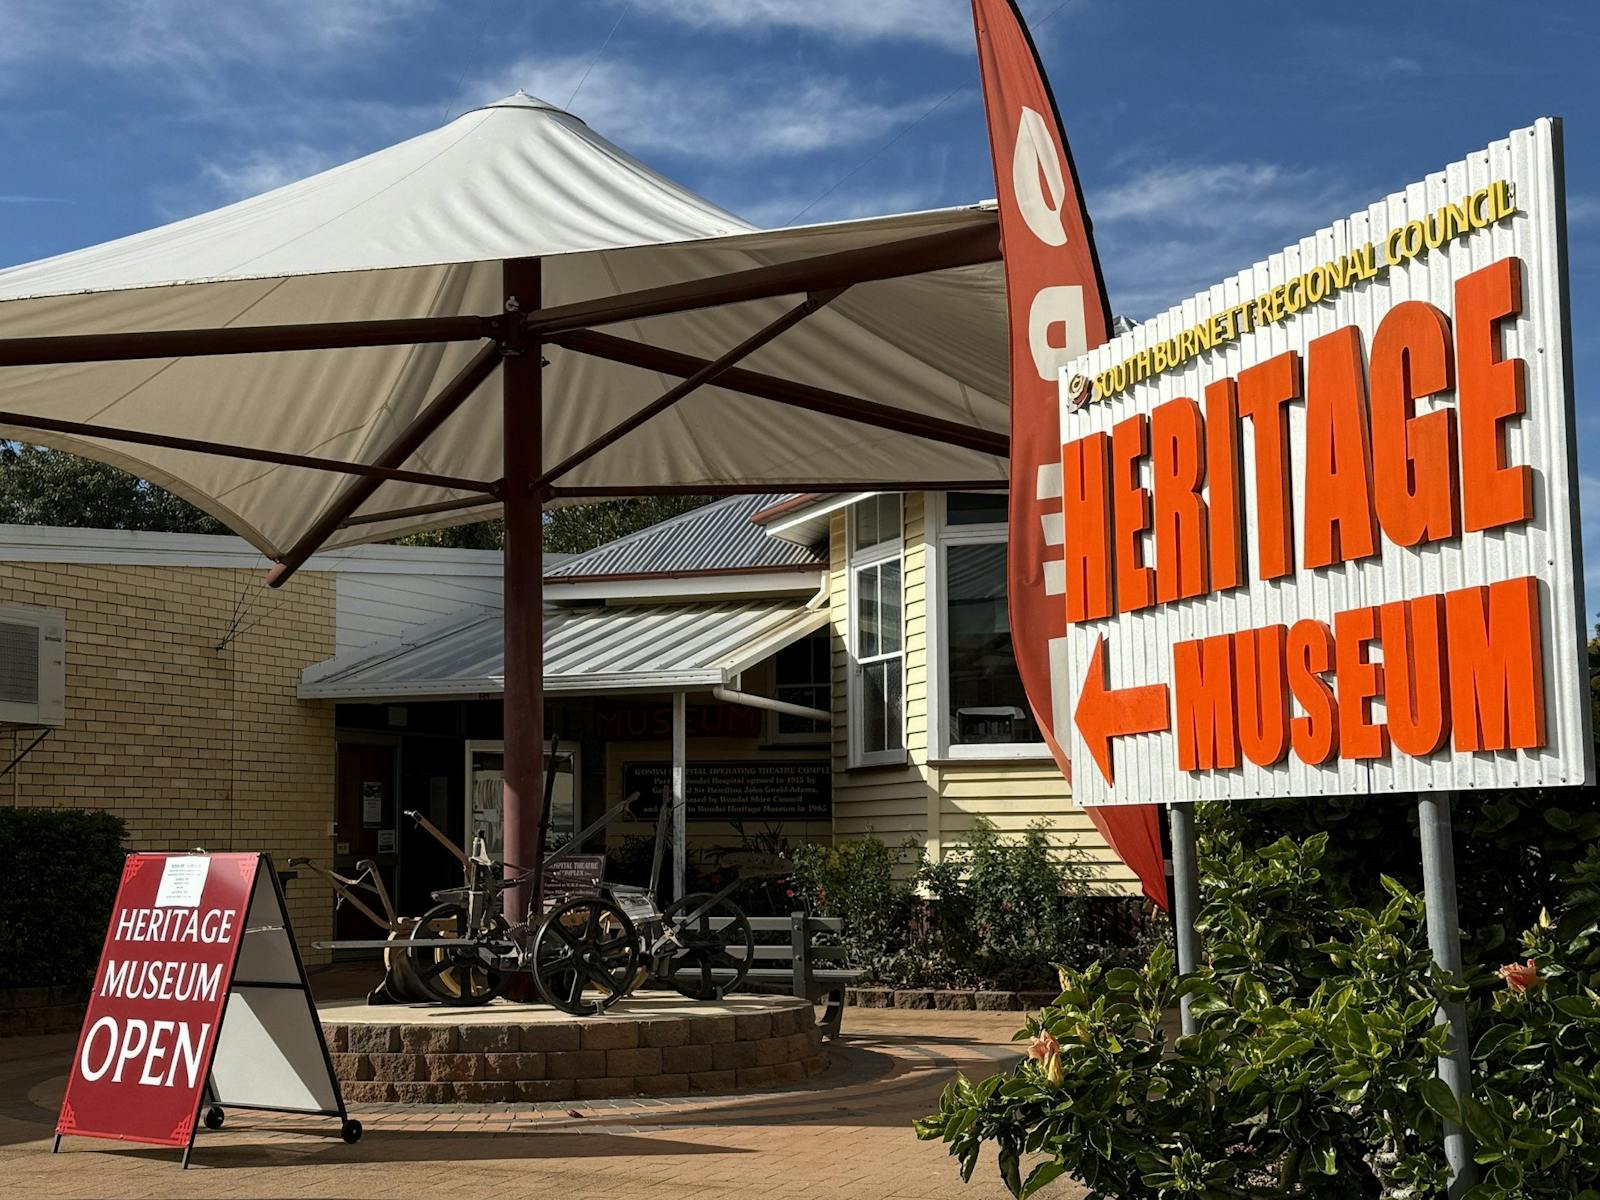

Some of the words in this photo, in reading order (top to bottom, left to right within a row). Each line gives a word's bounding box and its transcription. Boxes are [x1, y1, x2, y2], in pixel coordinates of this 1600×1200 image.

[1092, 348, 1152, 403] SOUTH
[1153, 301, 1255, 372] BURNETT
[1257, 242, 1378, 326] REGIONAL
[1384, 180, 1517, 266] COUNCIL
[1062, 256, 1534, 623] HERITAGE
[1173, 576, 1546, 771] MUSEUM
[709, 767, 756, 775] OPERATING
[758, 766, 795, 775] THEATRE
[711, 776, 743, 785] Hospital
[745, 776, 773, 786] opened
[775, 776, 785, 784] in
[806, 776, 817, 786] by
[707, 786, 742, 794] Hamilton
[743, 785, 763, 794] John
[707, 795, 718, 804] by
[719, 795, 748, 803] Wondai
[749, 795, 771, 803] Shire
[772, 795, 803, 803] Council
[696, 805, 726, 813] Wondai
[727, 805, 761, 814] Heritage
[114, 908, 236, 944] HERITAGE
[100, 959, 223, 1002] MUSEUM
[80, 1015, 211, 1089] OPEN
